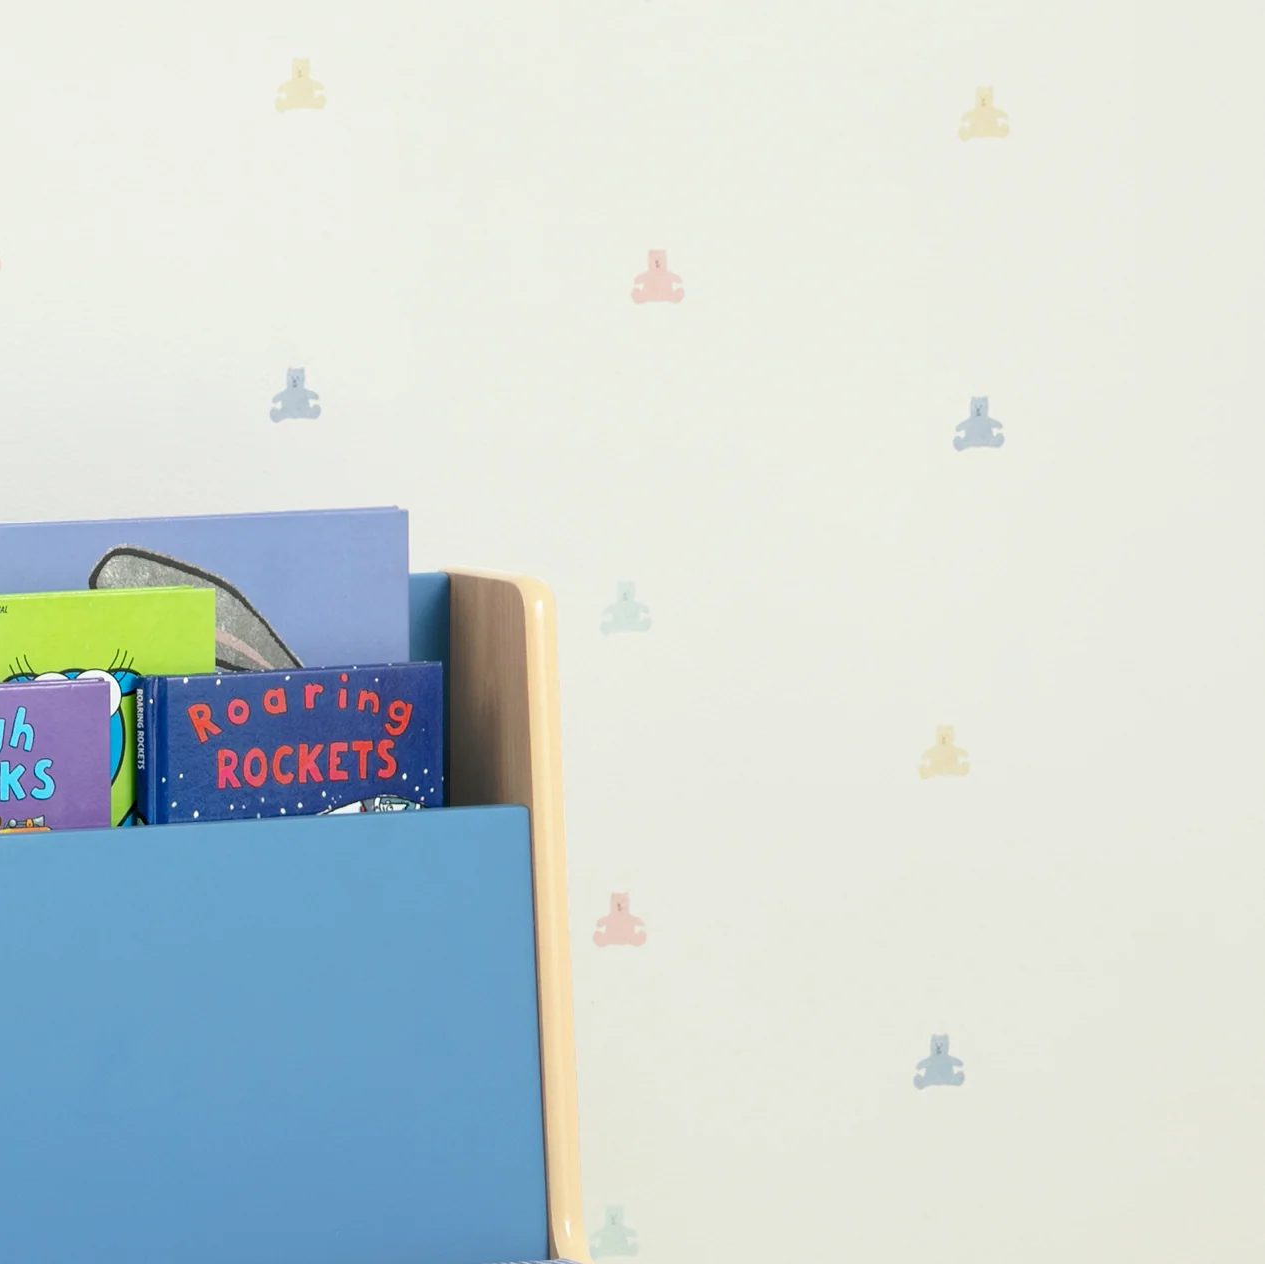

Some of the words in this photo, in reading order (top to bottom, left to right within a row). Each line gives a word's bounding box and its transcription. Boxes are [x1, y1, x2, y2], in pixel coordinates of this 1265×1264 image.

[136, 688, 144, 728] ROARING
[186, 672, 414, 744] Roaring
[137, 730, 145, 770] ROCKETS
[215, 738, 398, 790] ROCKETS
